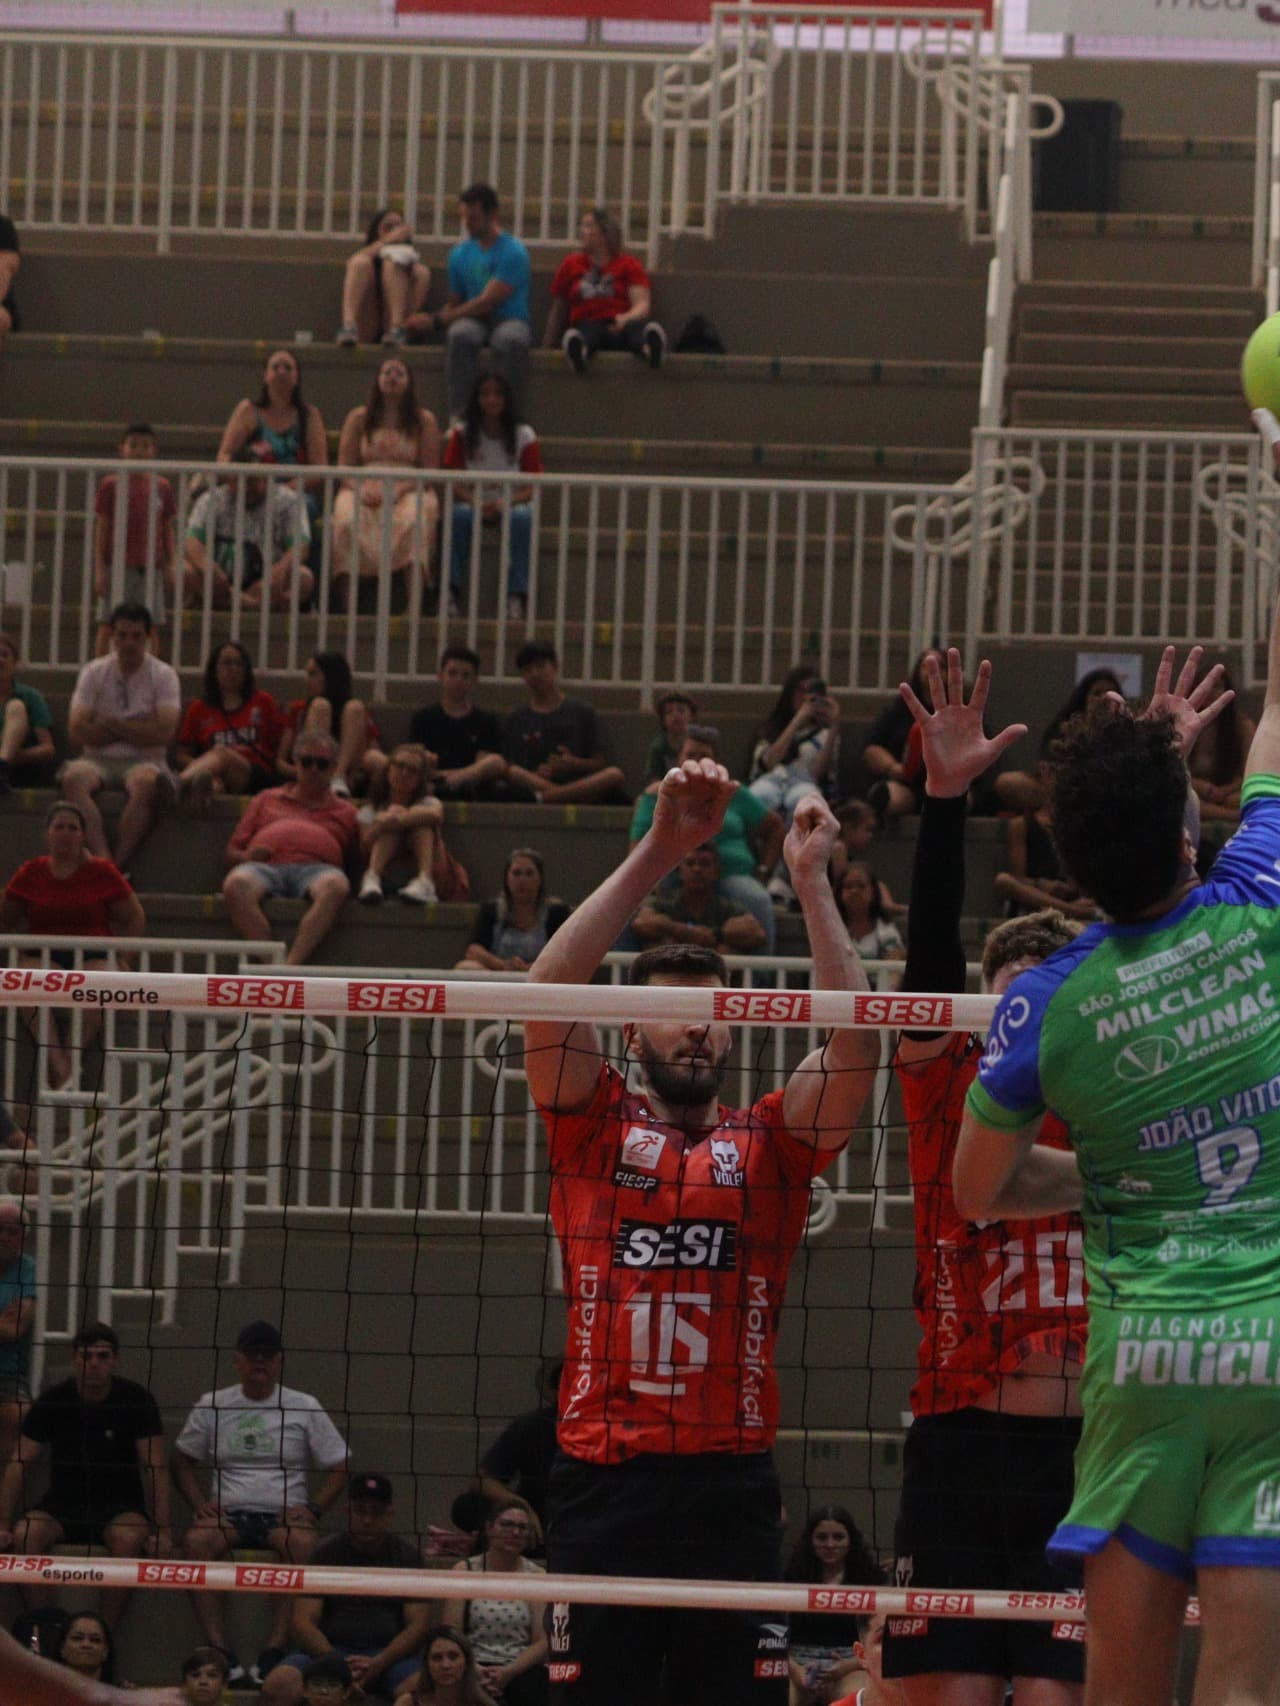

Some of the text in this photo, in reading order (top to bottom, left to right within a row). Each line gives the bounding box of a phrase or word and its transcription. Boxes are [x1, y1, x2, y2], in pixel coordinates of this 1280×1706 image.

[1160, 963, 1196, 985] DOS
[1196, 928, 1259, 969] CAMPOS
[72, 988, 159, 1006] esporte
[216, 981, 297, 1007] SESI
[356, 986, 437, 1011] SESI
[1096, 949, 1267, 1043] MILCLEAN
[722, 996, 803, 1020] SESI
[863, 1000, 944, 1024] SESI
[1175, 982, 1276, 1047] VINAC
[1138, 1105, 1213, 1151] JOÃO
[1196, 1124, 1261, 1206] 9
[622, 1224, 724, 1267] SESI
[982, 1230, 1084, 1314] 20
[624, 1293, 711, 1376] 15
[42, 1568, 105, 1582] esporte
[143, 1565, 200, 1583] SESI
[241, 1569, 298, 1587] SESI
[813, 1591, 870, 1609] SESI
[911, 1594, 969, 1613] SESI
[1056, 1623, 1087, 1641] SE
